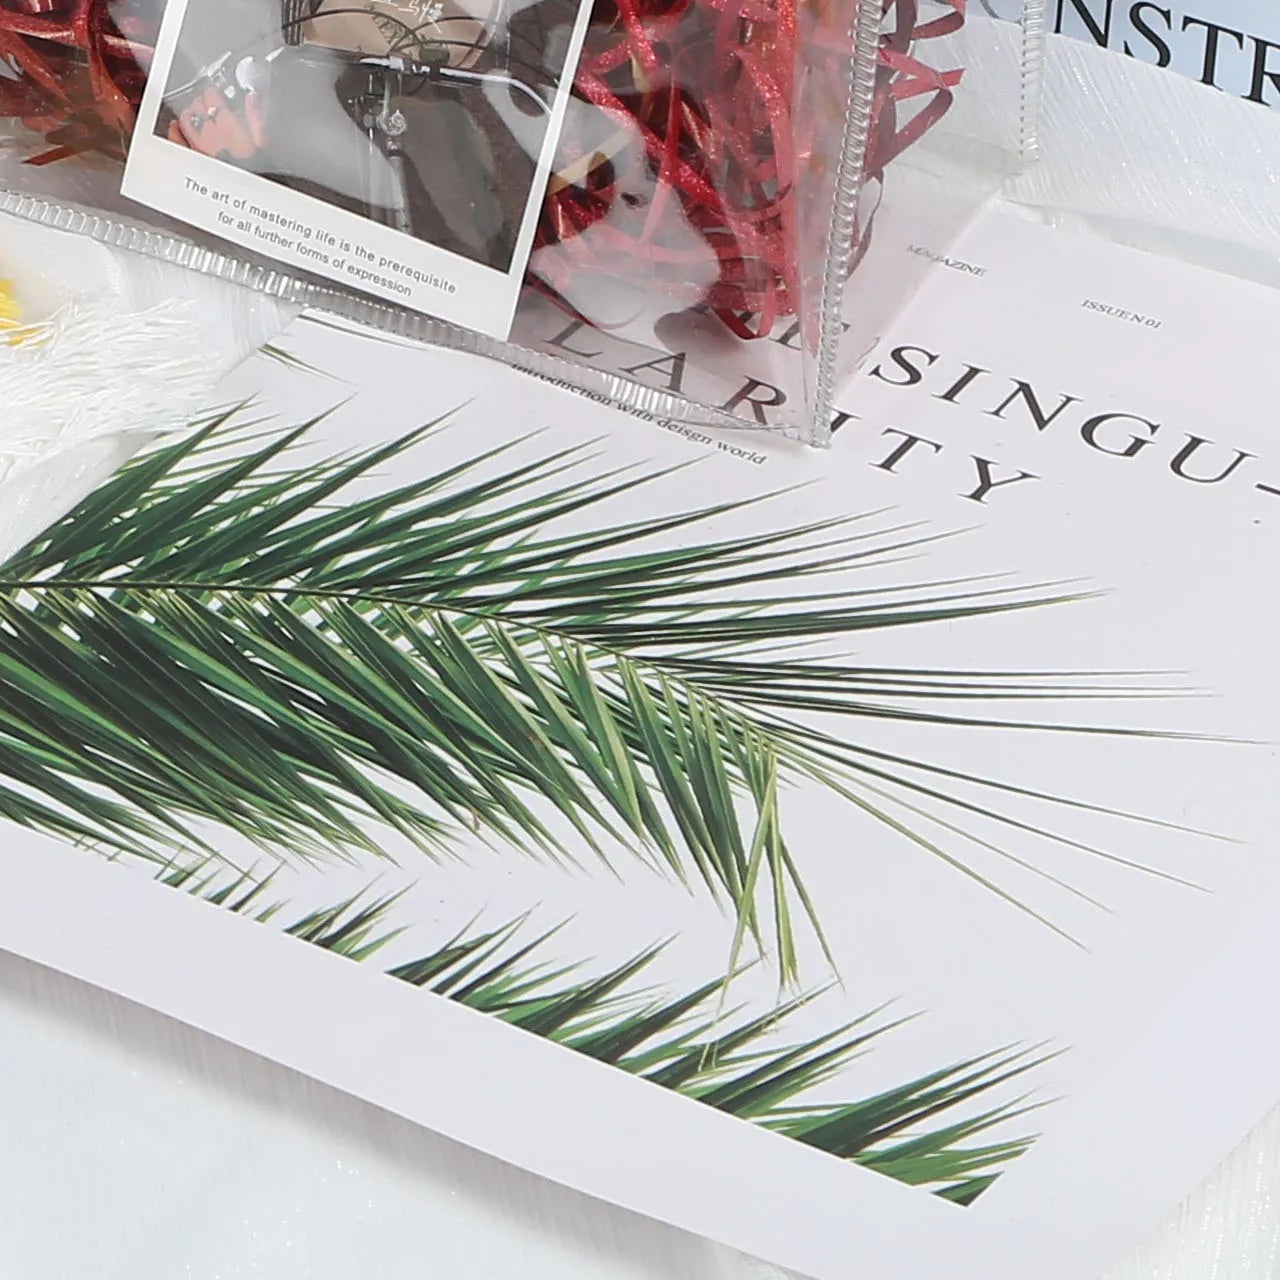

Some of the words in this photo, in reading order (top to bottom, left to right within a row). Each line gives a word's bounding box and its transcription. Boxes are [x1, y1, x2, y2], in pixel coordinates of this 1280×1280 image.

[184, 177, 208, 196] The
[211, 190, 230, 205] art
[232, 198, 248, 211] of
[249, 203, 313, 239] mastering
[315, 229, 336, 246] life
[339, 238, 351, 253] is
[355, 244, 376, 262] the
[379, 255, 457, 295] prerequisite
[217, 210, 235, 227] for
[236, 219, 252, 235] all
[254, 224, 293, 250] further
[295, 241, 330, 264] forms
[332, 257, 347, 271] of
[346, 264, 412, 298] expression
[617, 401, 654, 423] with
[717, 439, 768, 466] world
[868, 344, 1280, 497] SINGU-
